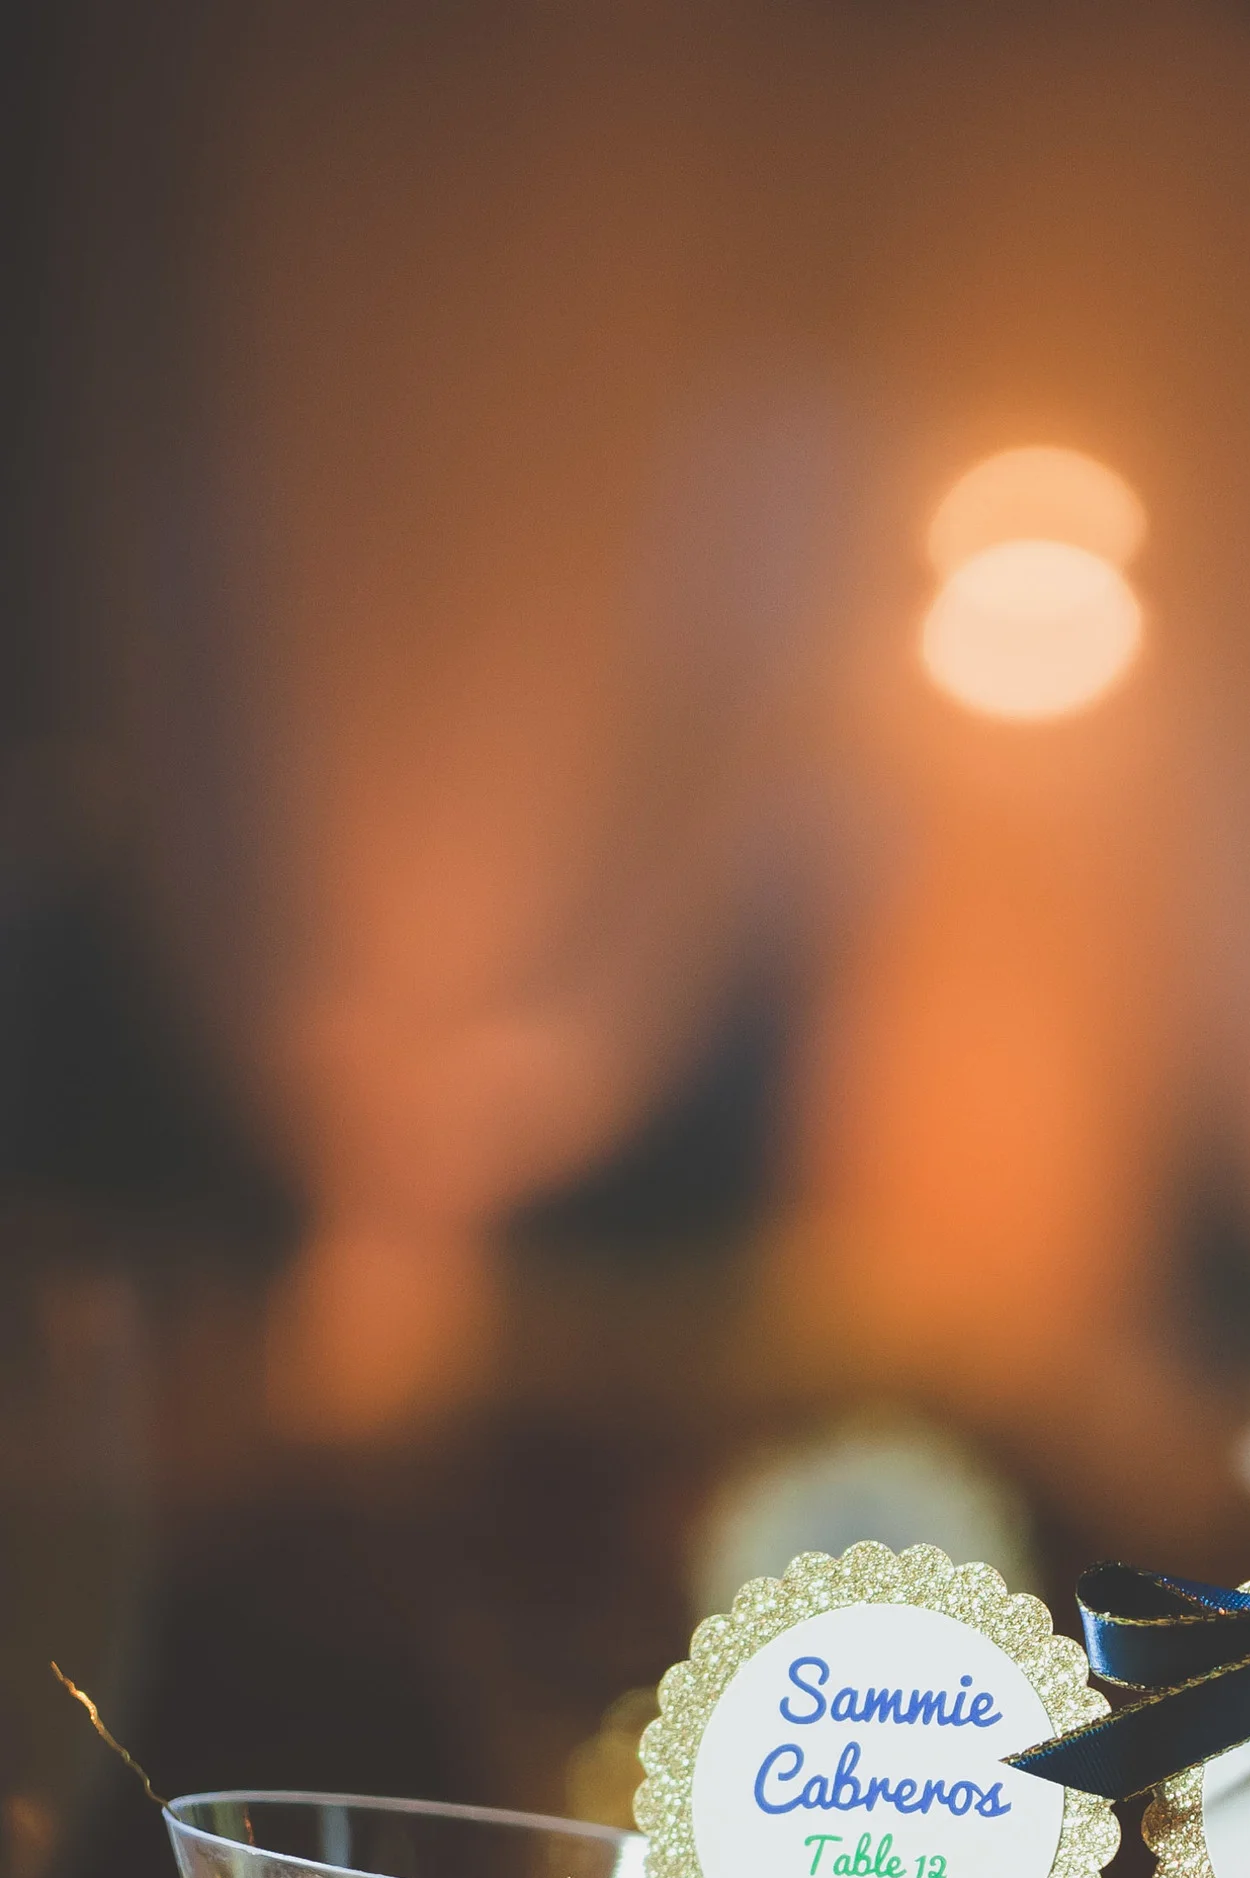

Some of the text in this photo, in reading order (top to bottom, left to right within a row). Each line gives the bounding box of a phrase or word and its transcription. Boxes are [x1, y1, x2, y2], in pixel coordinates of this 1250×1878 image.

[779, 1656, 1003, 1728] Sammie
[754, 1741, 1012, 1818] Cabreros
[804, 1832, 907, 1878] Table
